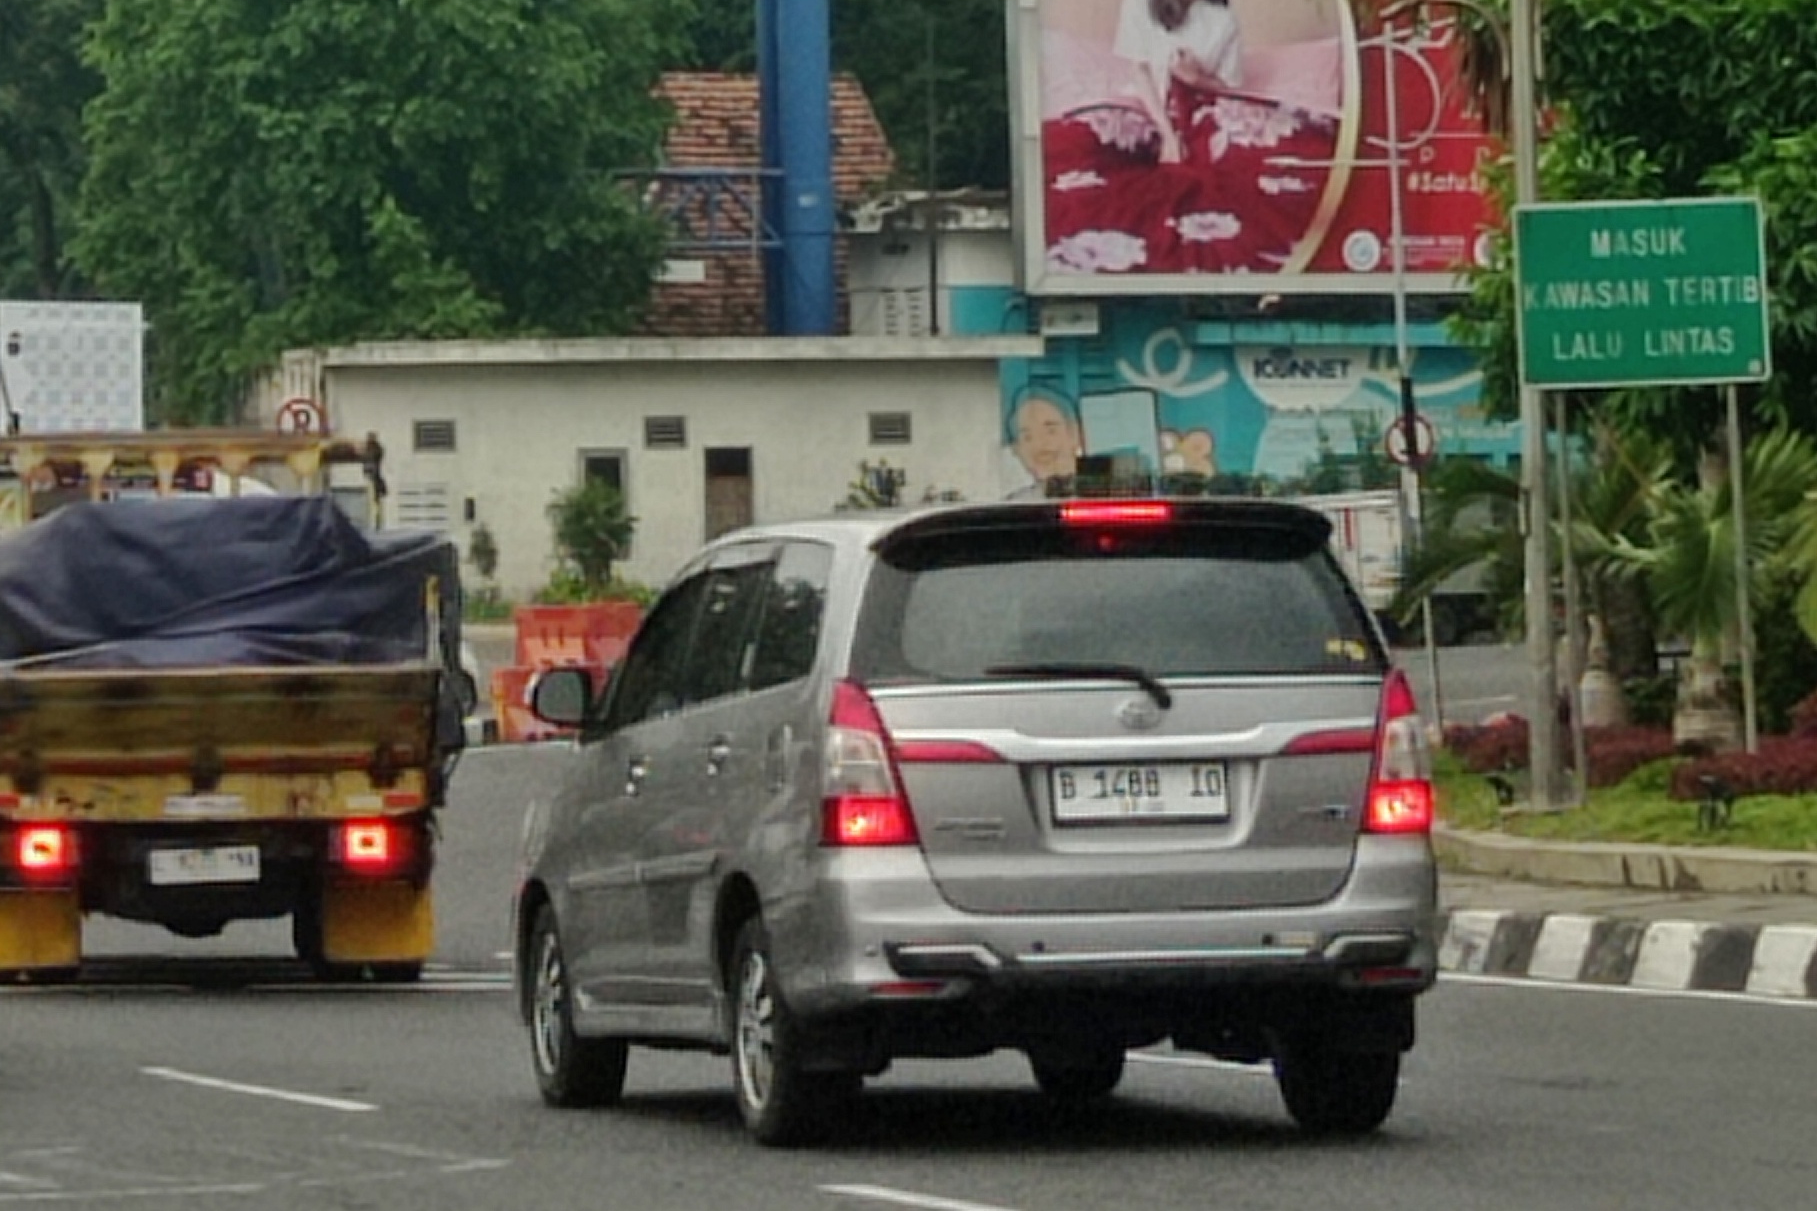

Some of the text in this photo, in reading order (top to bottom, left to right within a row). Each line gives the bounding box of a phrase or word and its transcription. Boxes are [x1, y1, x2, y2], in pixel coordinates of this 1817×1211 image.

[1590, 227, 1686, 257] MASUK
[1523, 275, 1760, 312] KAWASAN TERTIB
[1552, 326, 1735, 360] LALU LINTAS
